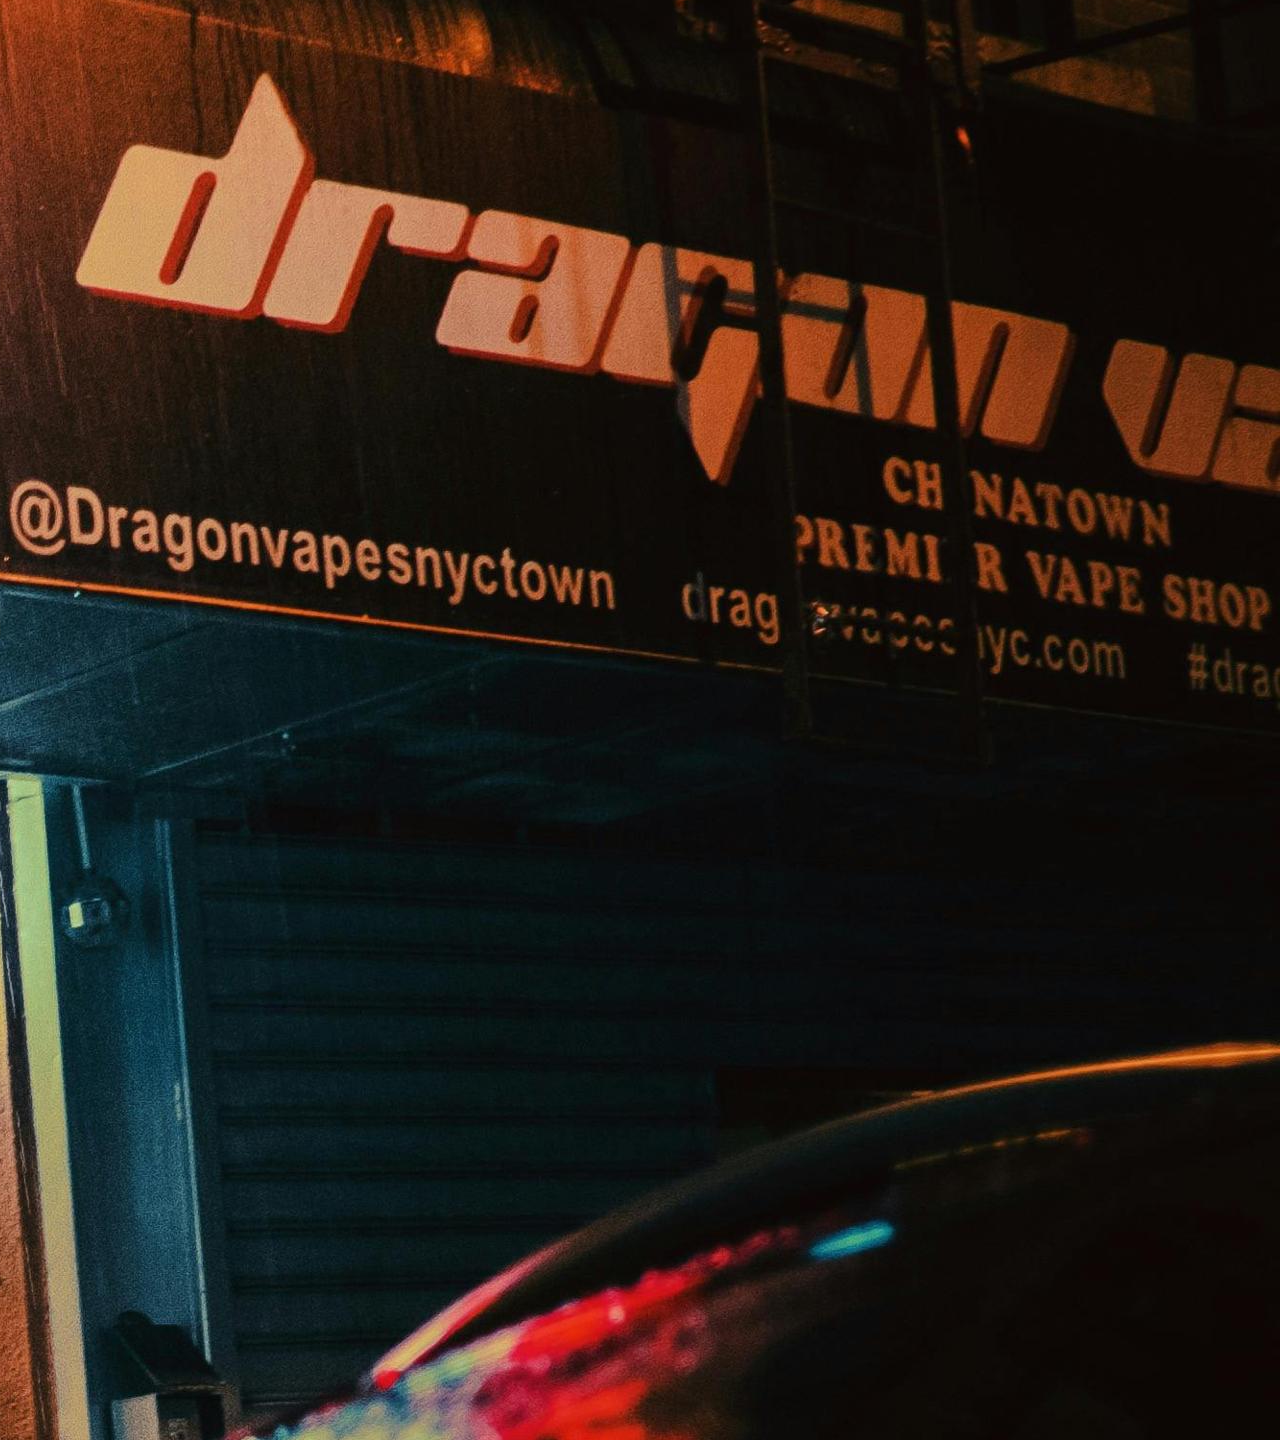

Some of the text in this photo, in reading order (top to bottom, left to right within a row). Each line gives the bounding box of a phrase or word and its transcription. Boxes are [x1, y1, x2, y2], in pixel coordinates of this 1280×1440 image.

[8, 479, 617, 611] @Dragonvapesnyctown
[882, 457, 1172, 548] CHNATOWN
[794, 514, 1272, 631] PREMIR VAPE SHOP
[1188, 642, 1280, 709] #dra
